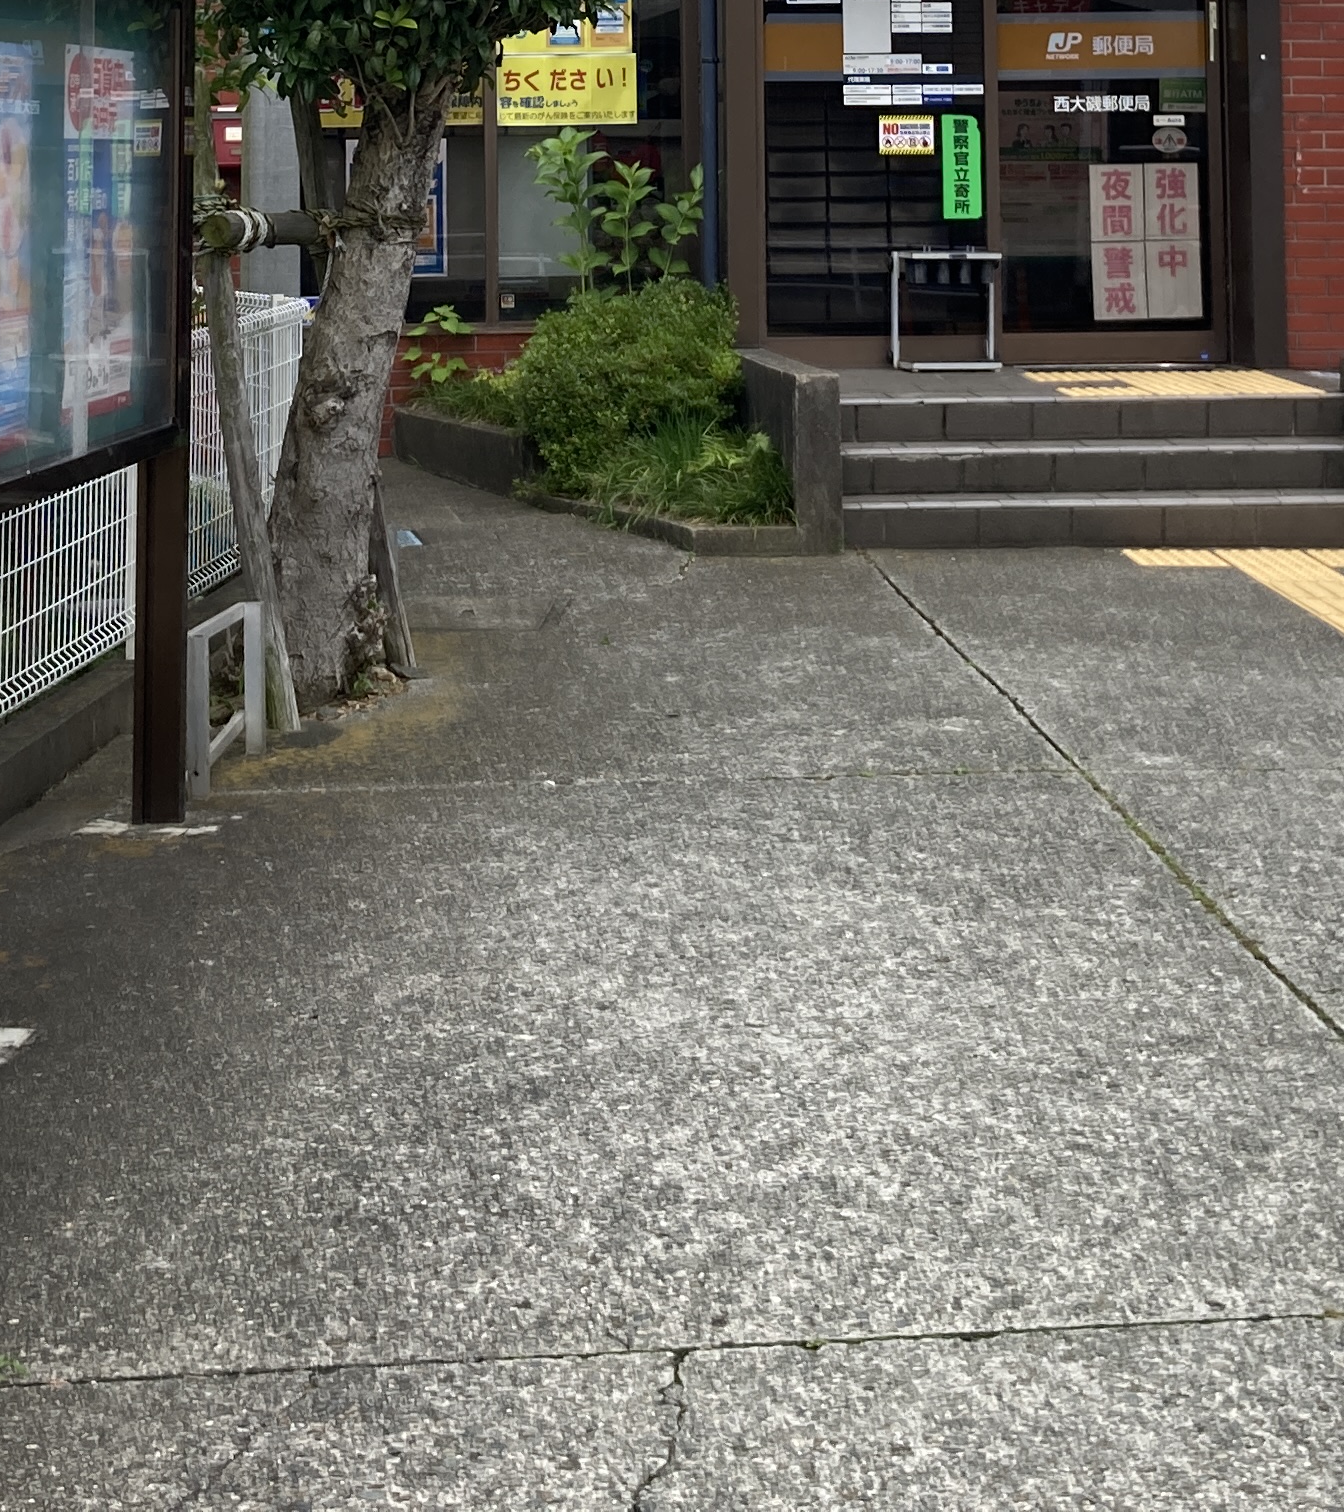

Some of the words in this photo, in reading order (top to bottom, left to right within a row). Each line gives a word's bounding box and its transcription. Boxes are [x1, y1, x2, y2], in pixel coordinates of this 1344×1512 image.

[1092, 35, 1154, 56] 郵便局
[882, 123, 899, 135] NO
[1053, 94, 1151, 113] 西大磯郵便局
[953, 118, 970, 215] 警察官立寄所
[1100, 168, 1137, 315] 夜間警戒
[1155, 167, 1188, 278] 強化中
